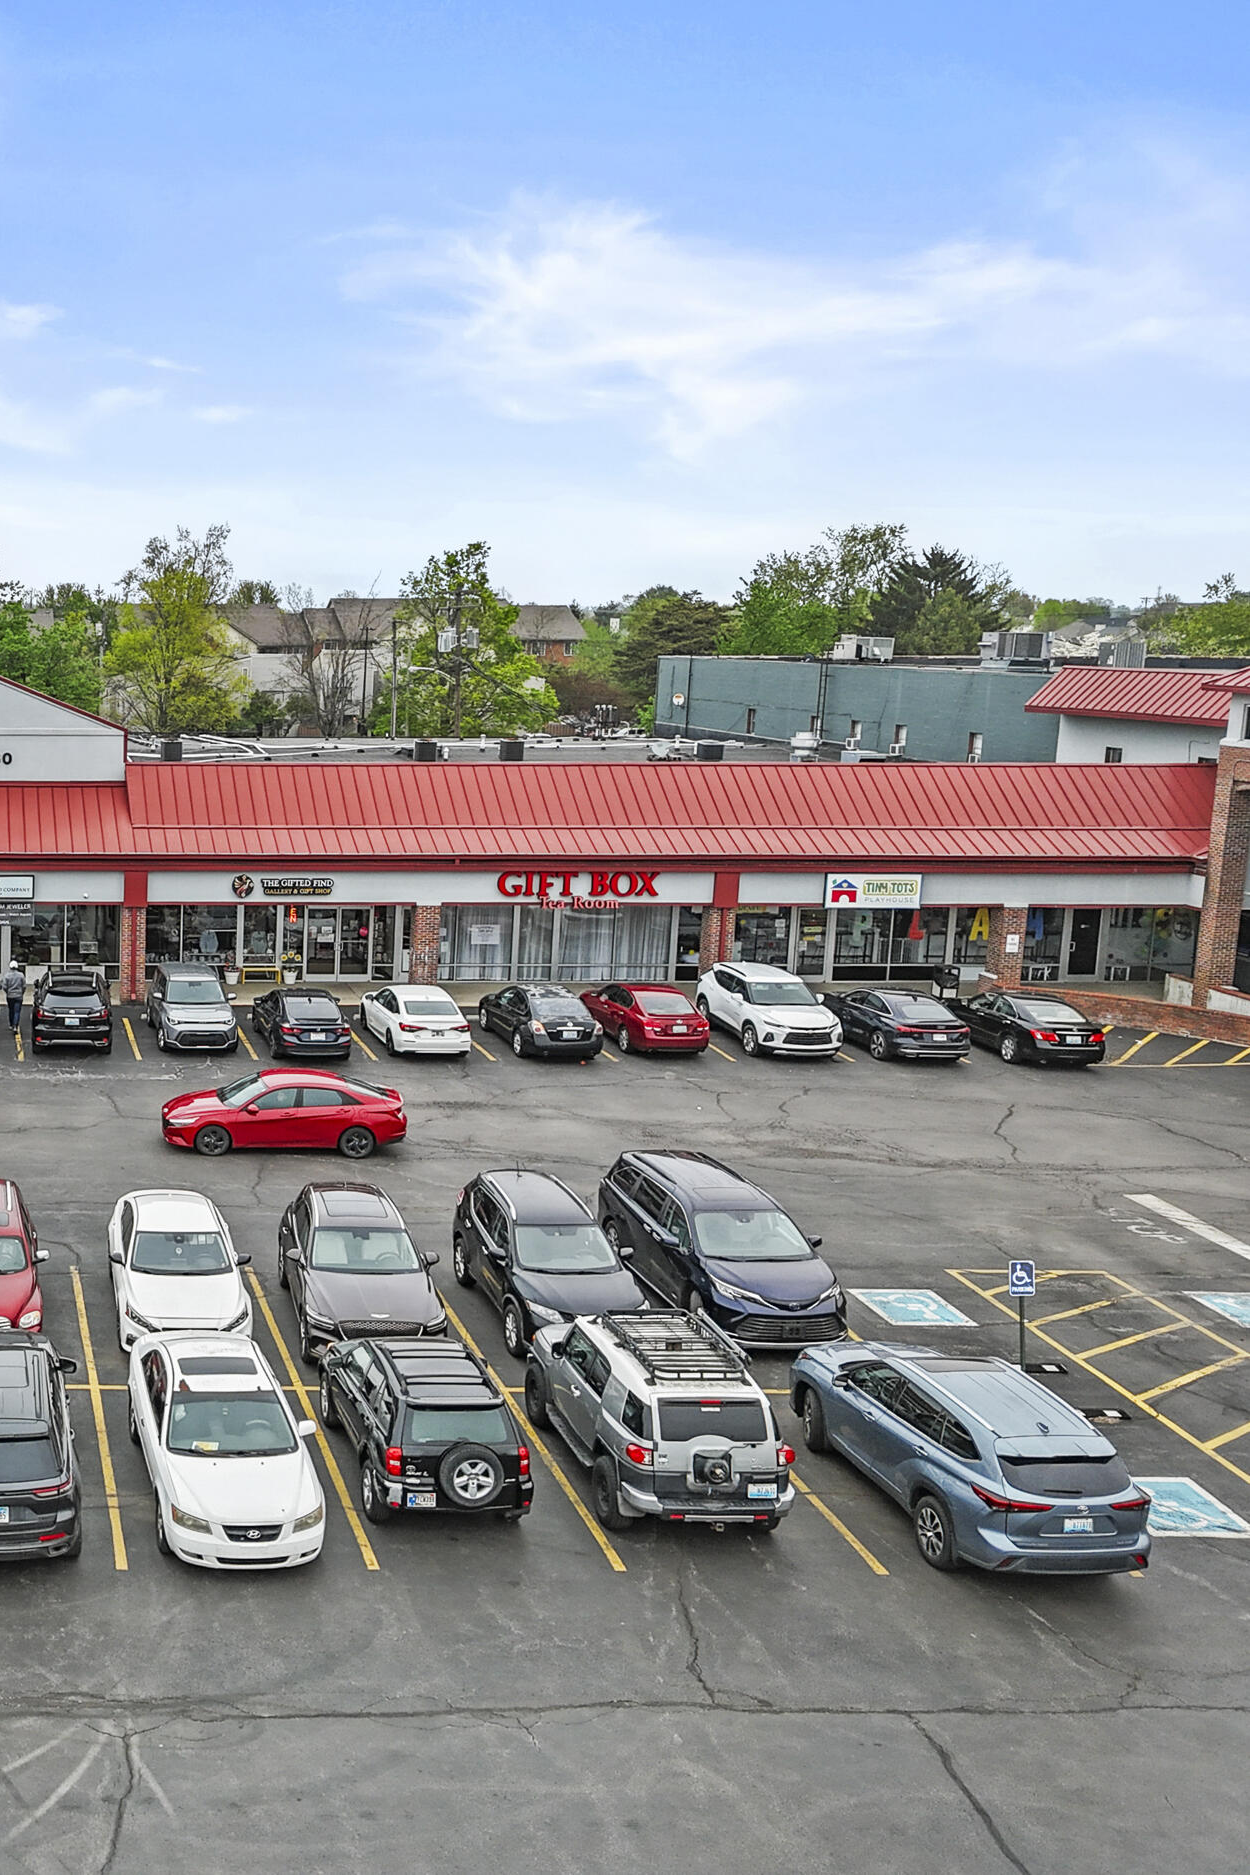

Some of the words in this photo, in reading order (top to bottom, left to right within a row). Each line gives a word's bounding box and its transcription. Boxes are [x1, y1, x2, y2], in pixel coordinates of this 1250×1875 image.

[262, 879, 280, 887] THE
[281, 879, 311, 887] GIFTED
[313, 879, 334, 887] FIND
[497, 871, 579, 897] GIFT
[589, 871, 661, 897] BOX
[866, 882, 888, 893] TINY
[891, 882, 914, 893] TOTS
[539, 895, 565, 909] Tea
[571, 895, 619, 909] Room
